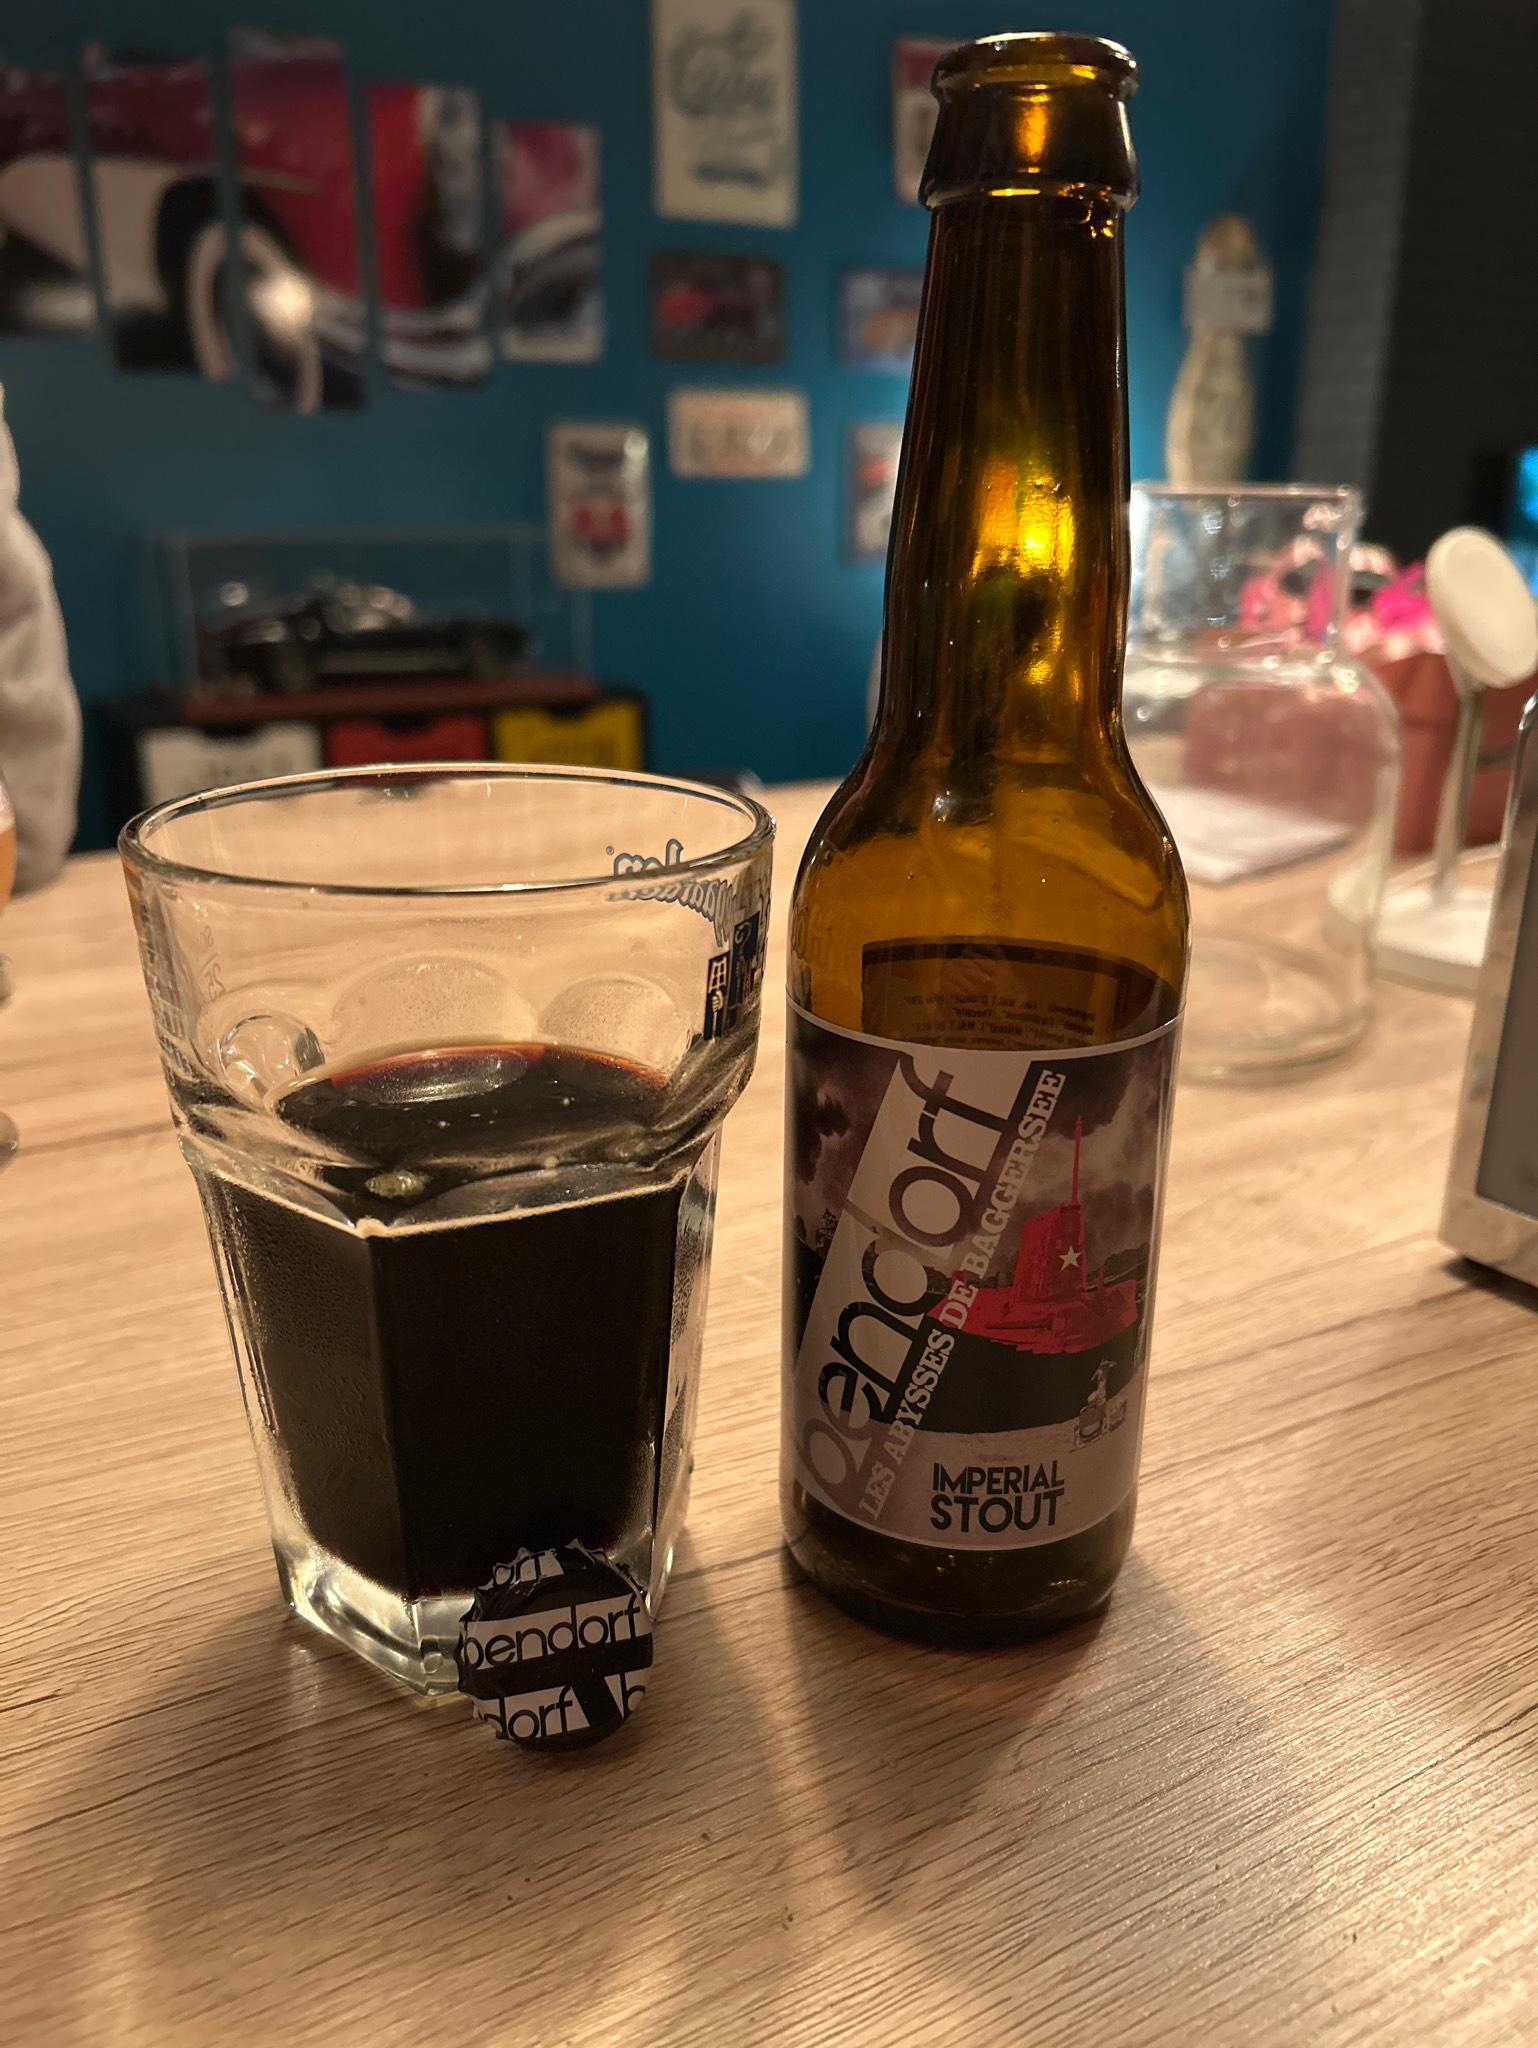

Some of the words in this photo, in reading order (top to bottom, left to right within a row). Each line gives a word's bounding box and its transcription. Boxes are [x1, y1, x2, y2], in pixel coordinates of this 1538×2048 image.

[858, 1461, 896, 1521] LES
[886, 1328, 955, 1465] ABYSSES
[938, 1279, 979, 1330] DE
[959, 1069, 1067, 1280] BAGGERSEE
[932, 1459, 1066, 1495] IMPERIAL
[929, 1489, 1066, 1534] STOUT
[463, 1592, 641, 1670] bendorf
